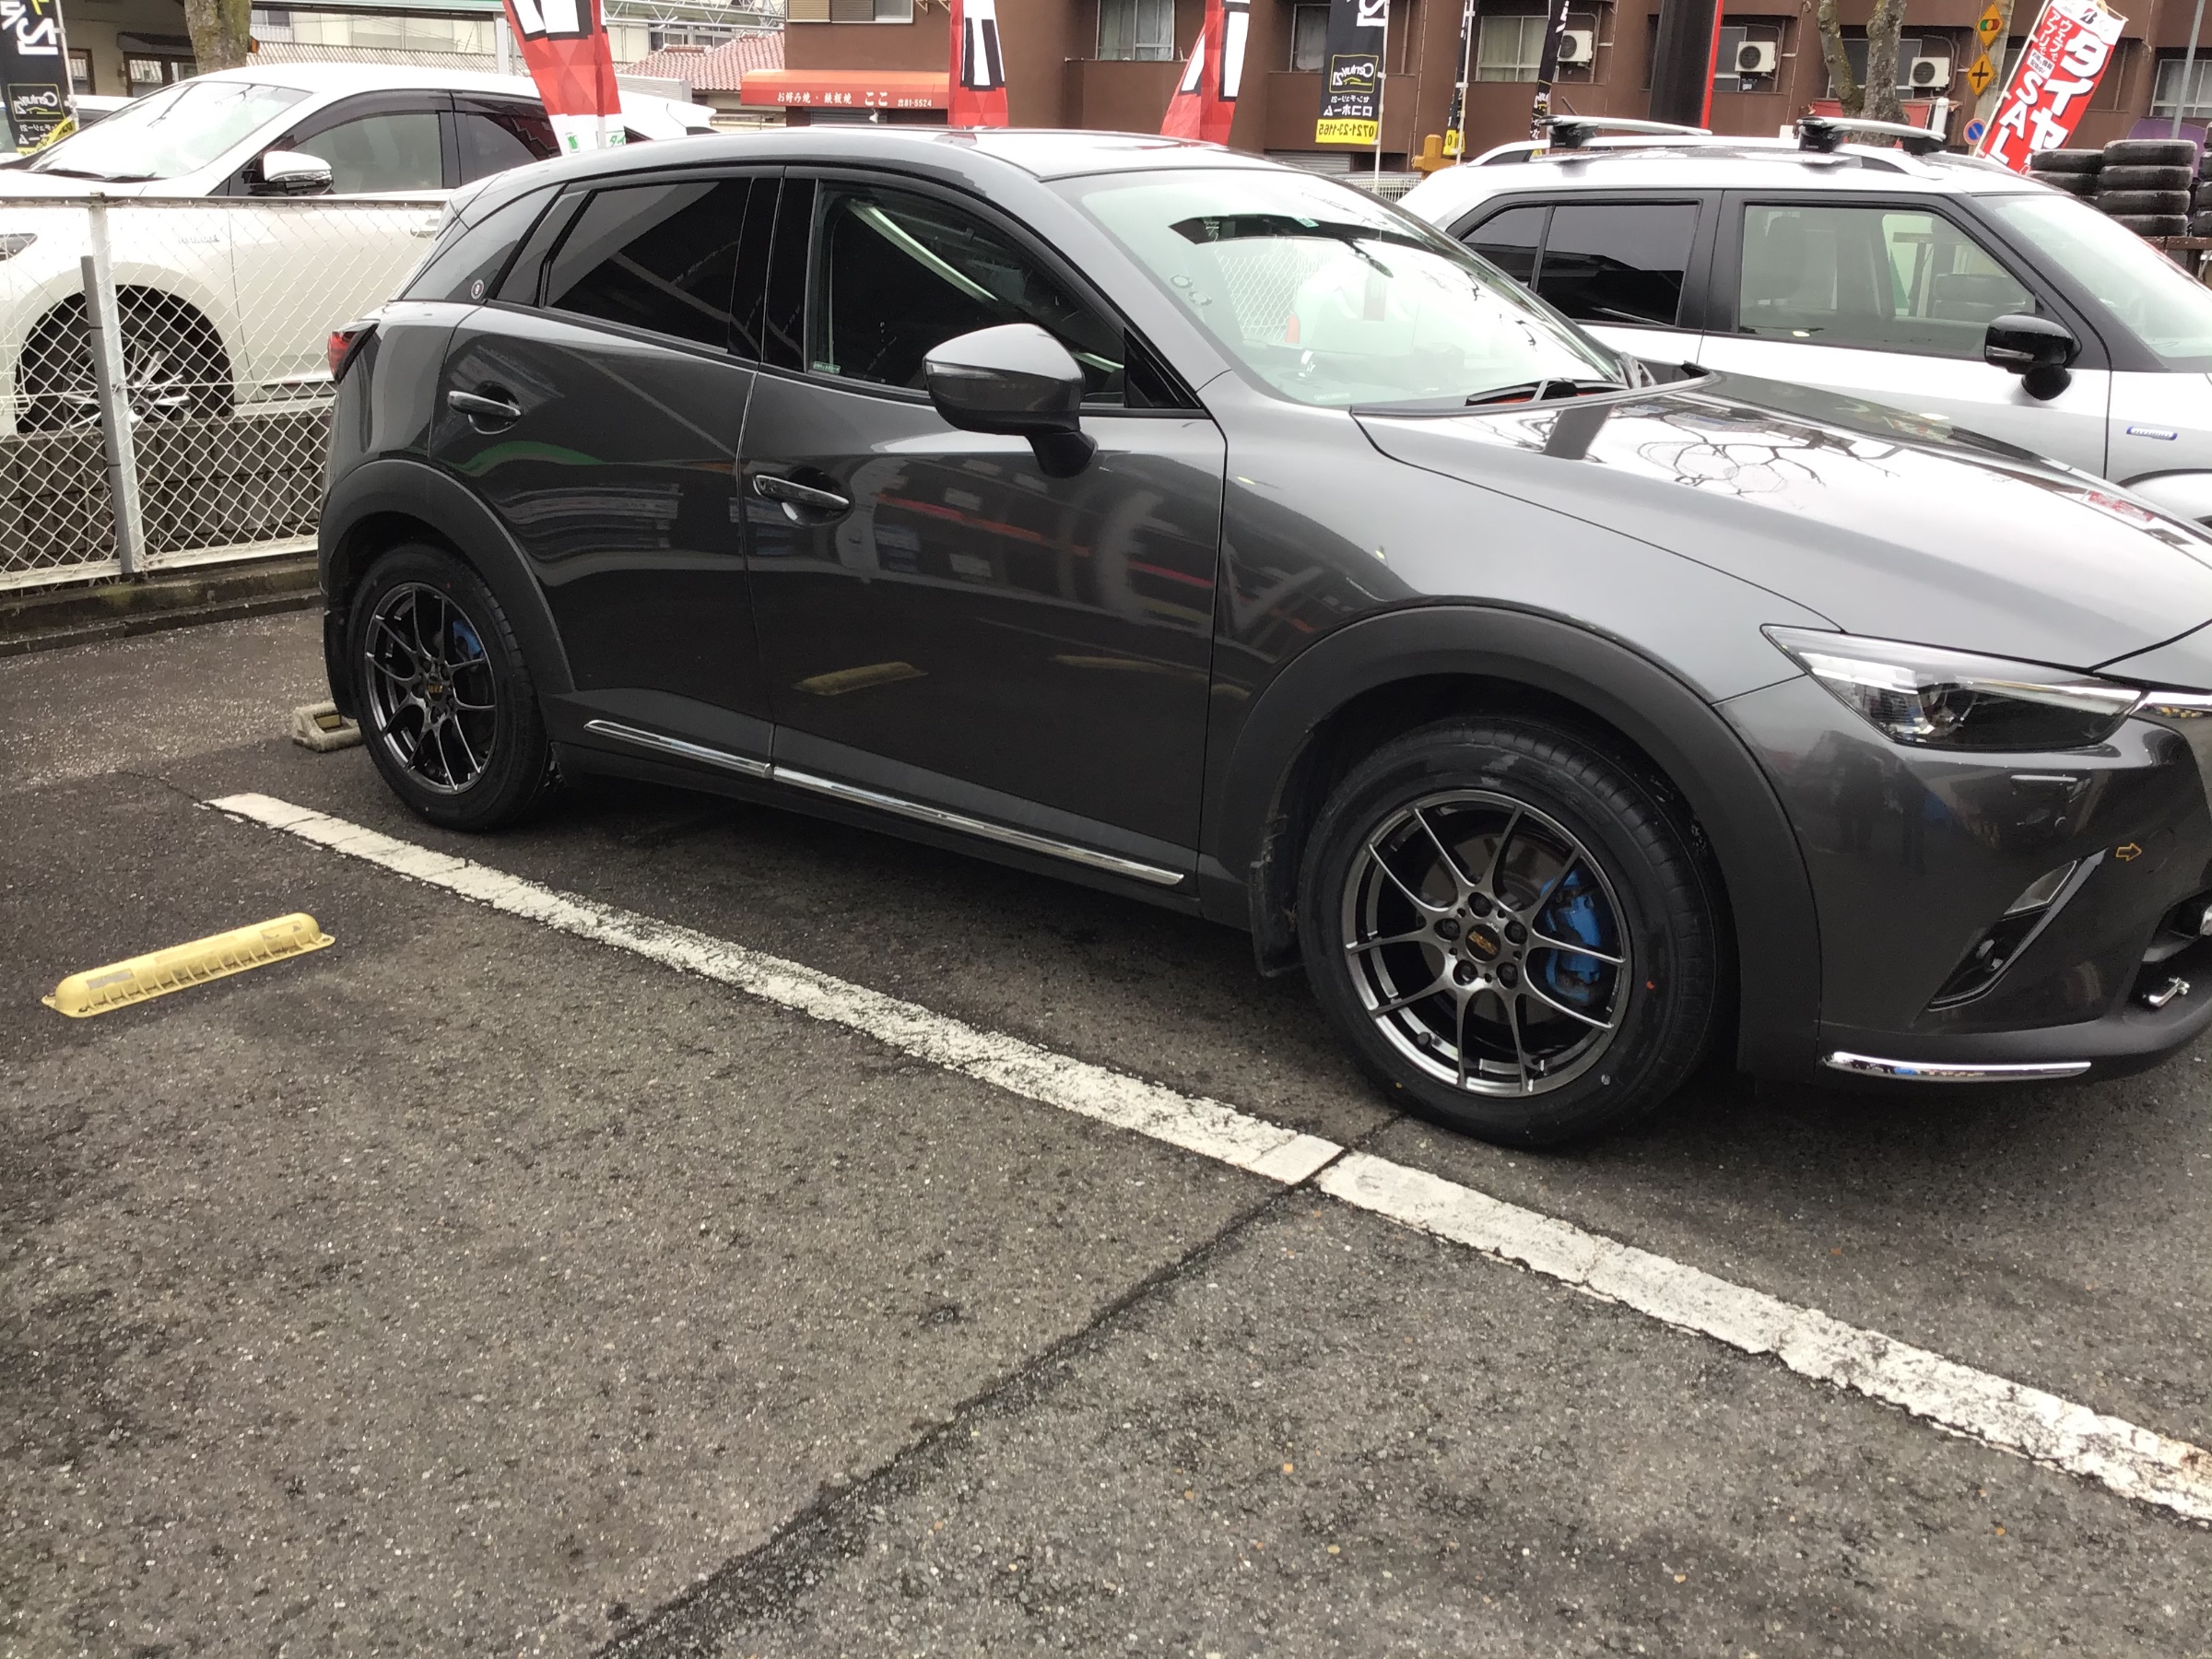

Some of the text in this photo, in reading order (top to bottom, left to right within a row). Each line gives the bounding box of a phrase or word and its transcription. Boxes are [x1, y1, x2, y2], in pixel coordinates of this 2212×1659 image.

[865, 91, 888, 107] ここ
[2030, 29, 2110, 152] タイヤ
